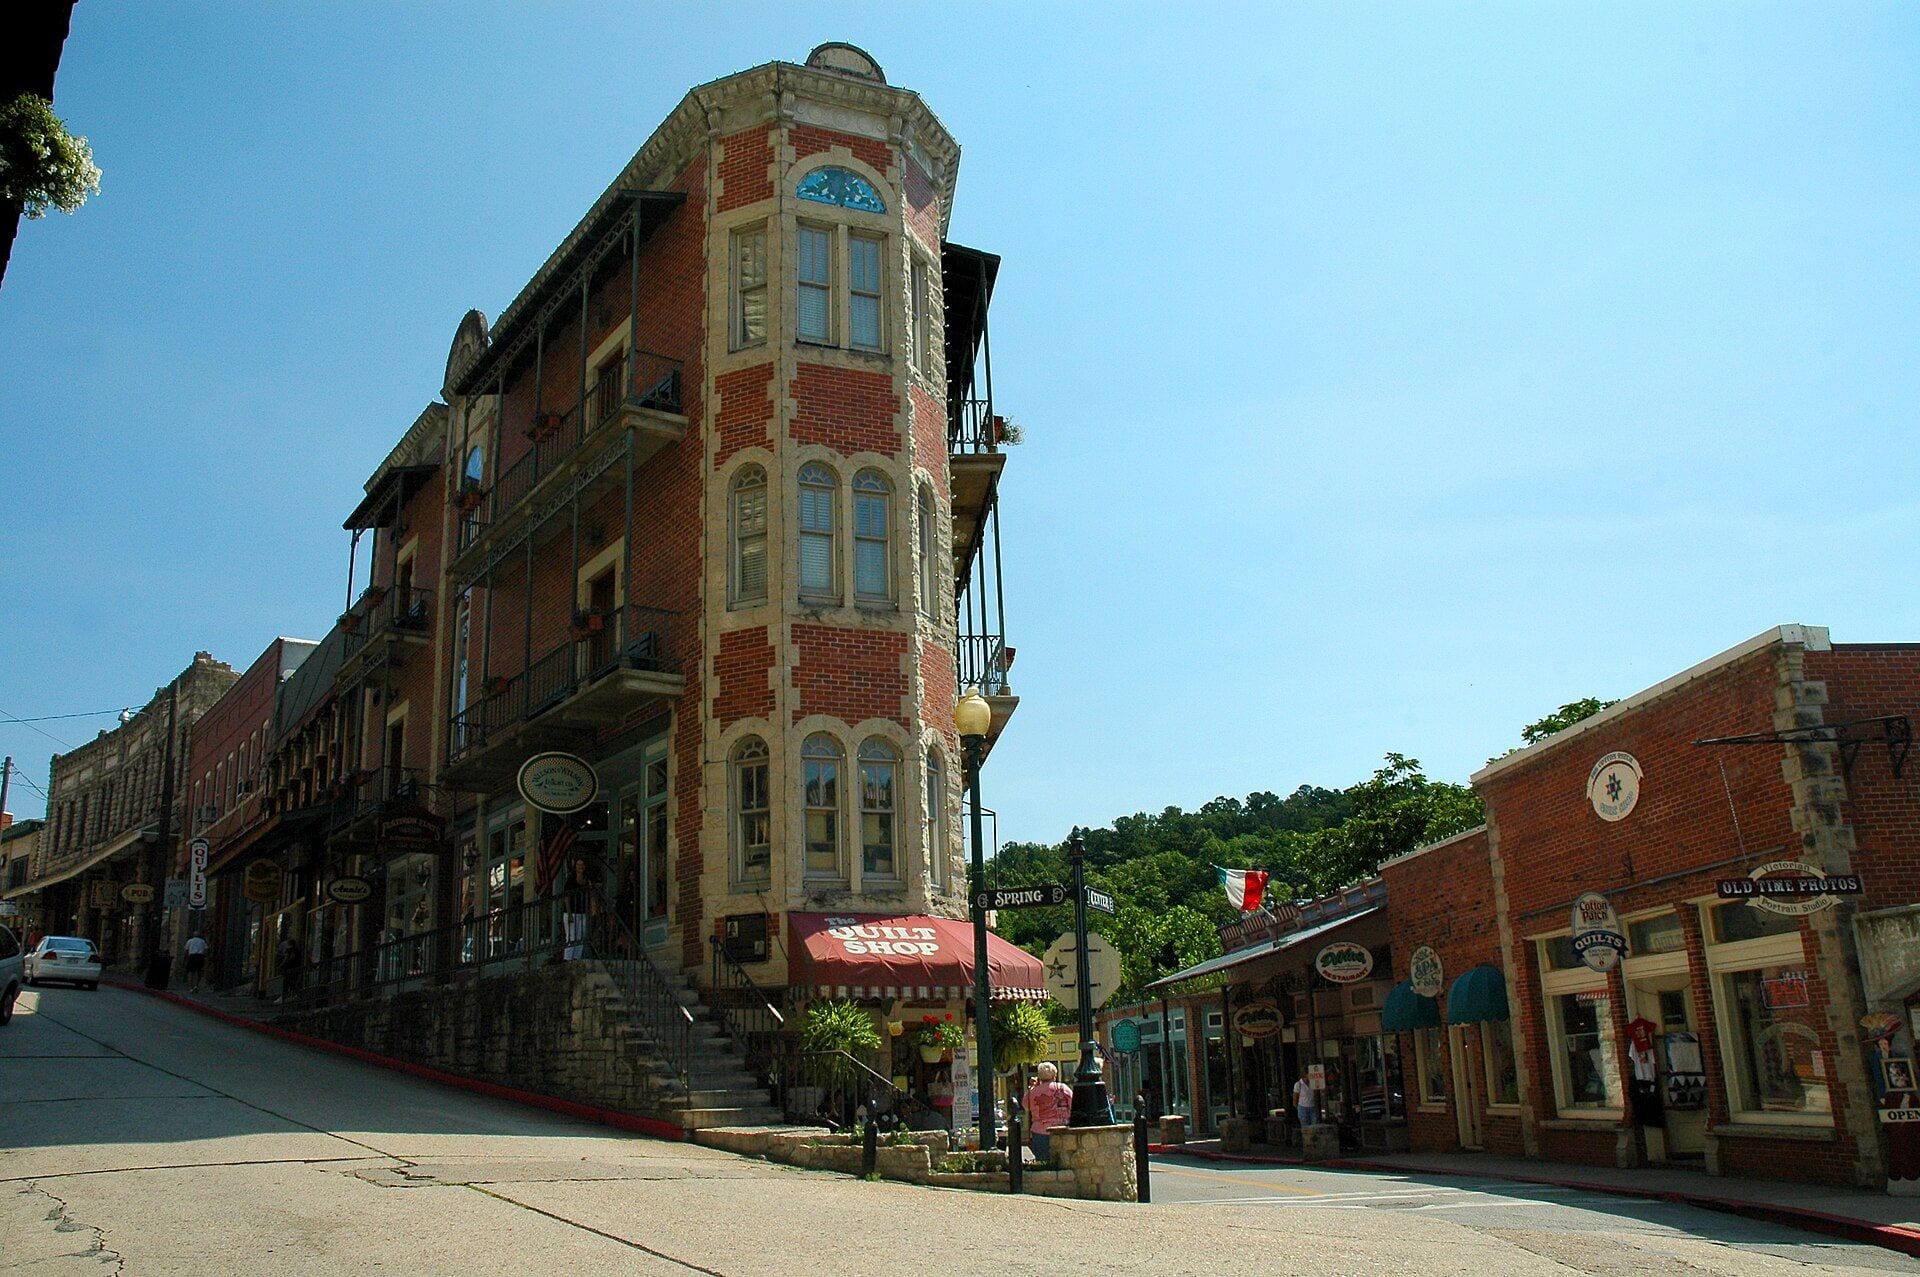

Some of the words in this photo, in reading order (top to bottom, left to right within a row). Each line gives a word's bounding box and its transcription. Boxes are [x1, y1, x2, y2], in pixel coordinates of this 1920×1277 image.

[193, 848, 206, 900] QUILTS
[1761, 862, 1811, 873] Victorian
[131, 889, 149, 897] PUB
[333, 884, 369, 893] Annie's
[1722, 881, 1753, 895] OLD
[1756, 879, 1794, 893] TIME
[1799, 877, 1858, 892] PHOTOS
[995, 889, 1044, 907] SPRING
[1090, 890, 1110, 910] CENTER
[1761, 897, 1798, 913] Portrait
[1801, 898, 1828, 913] Studio
[1579, 901, 1608, 911] Cotton
[823, 917, 857, 926] The
[1582, 911, 1608, 922] Patch
[828, 925, 937, 941] QUILT
[842, 940, 941, 956] SHOP
[1574, 934, 1623, 950] QUILTS
[1322, 967, 1369, 982] RESTAURANT
[1239, 1025, 1280, 1037] RESTAURANT
